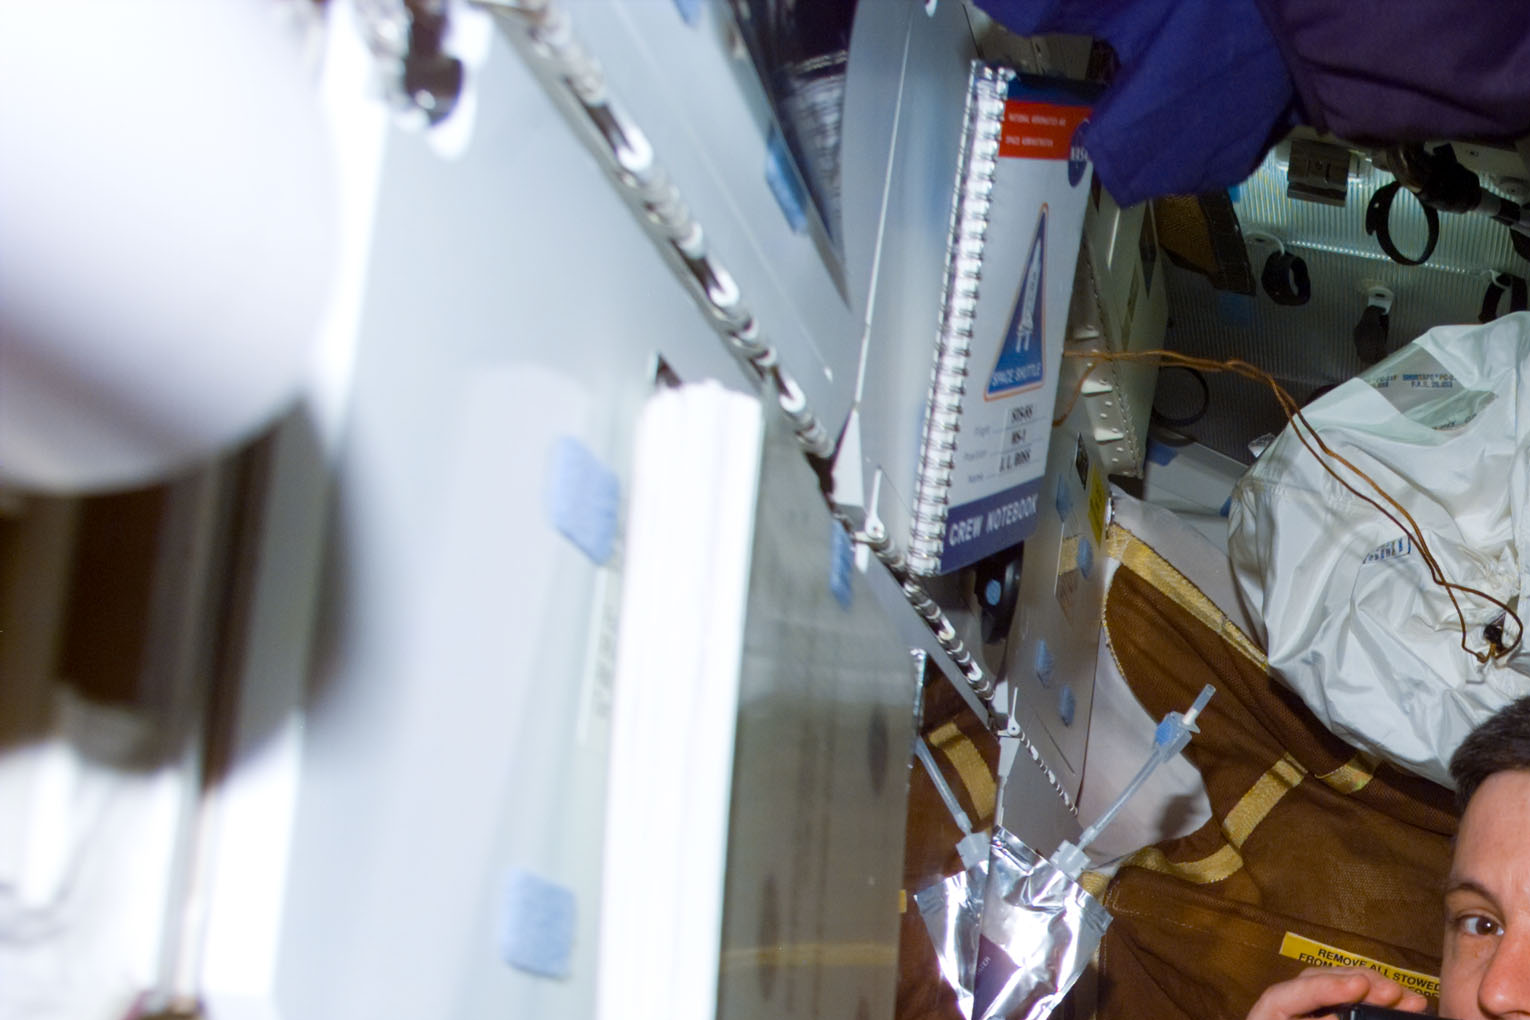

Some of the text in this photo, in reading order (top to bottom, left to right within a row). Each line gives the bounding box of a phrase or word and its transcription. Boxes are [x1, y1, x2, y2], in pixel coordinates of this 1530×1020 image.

[948, 493, 1039, 547] CREW NOTEBOOK
[1298, 952, 1334, 968] FROM
[1317, 947, 1440, 992] REMOVE ALL STOWED
